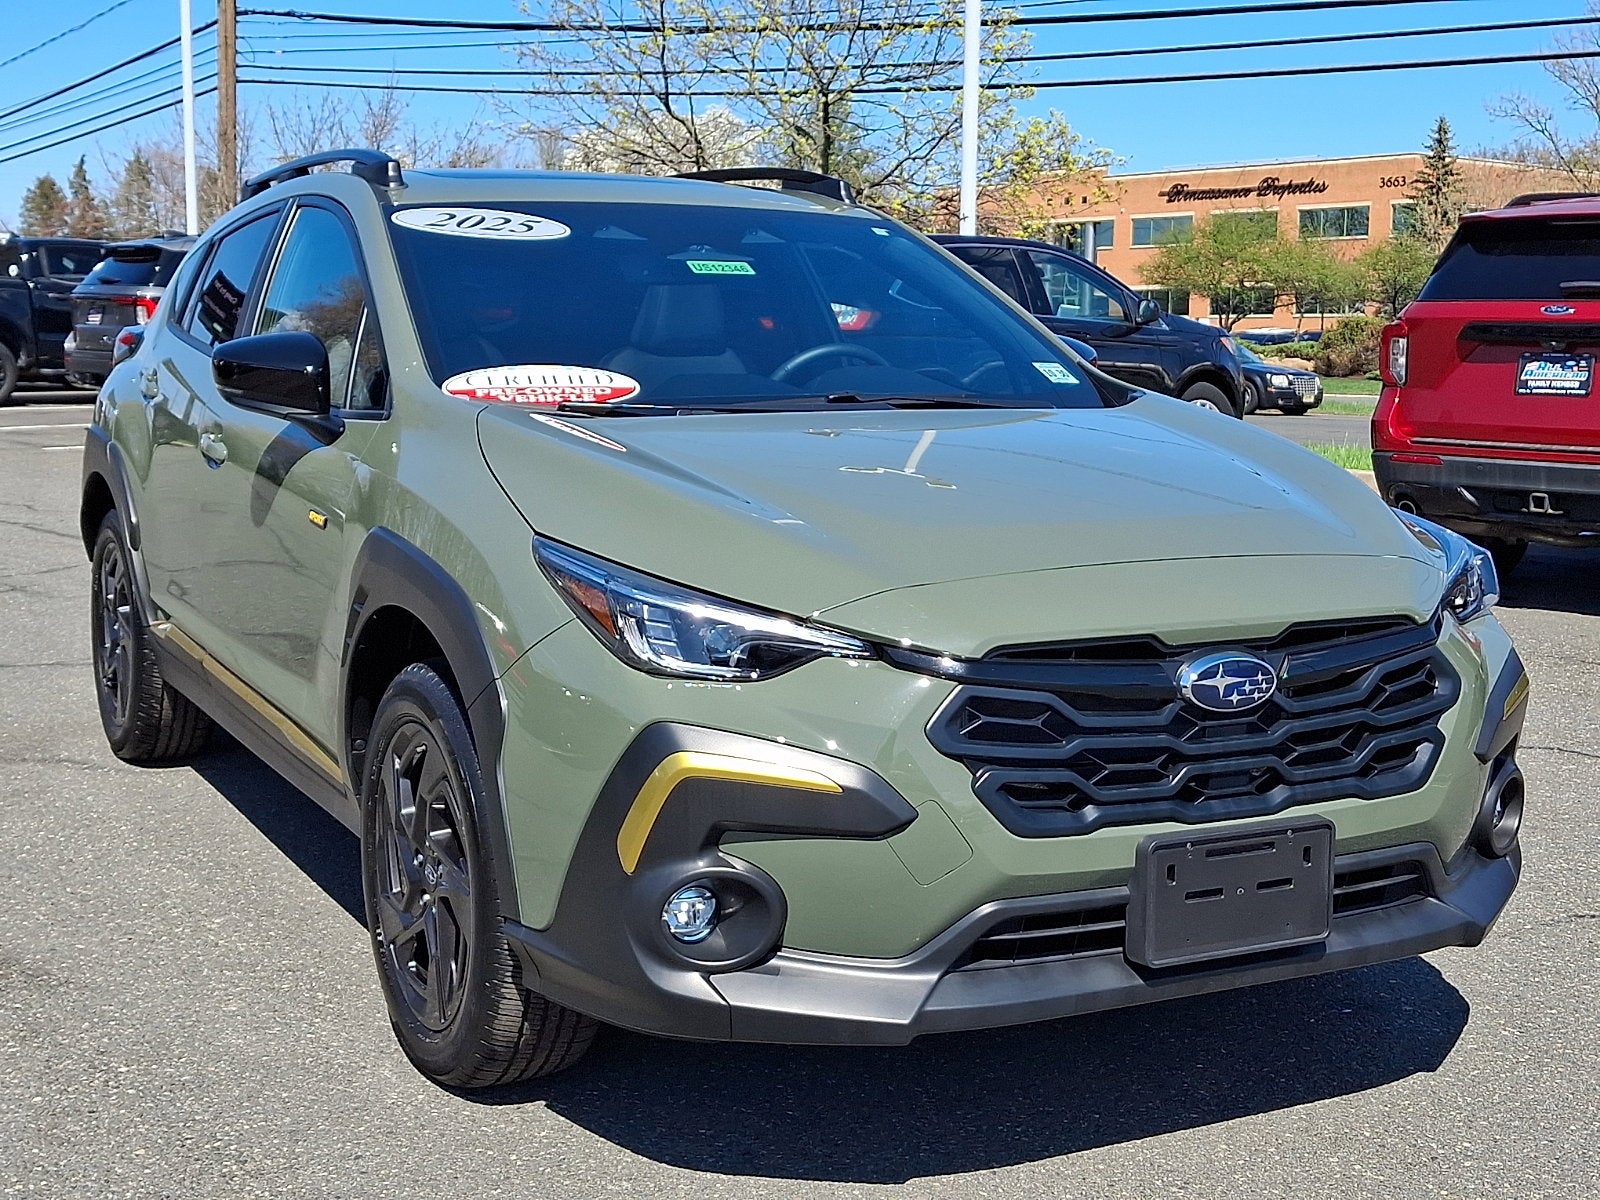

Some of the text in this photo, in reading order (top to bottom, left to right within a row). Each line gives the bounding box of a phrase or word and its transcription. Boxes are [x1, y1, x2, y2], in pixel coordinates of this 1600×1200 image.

[1379, 176, 1407, 188] 3663
[1166, 176, 1329, 203] Renaissance Properties
[424, 212, 542, 233] 2025
[475, 387, 612, 396] PRE-OWNED
[499, 394, 596, 402] VEHICLE
